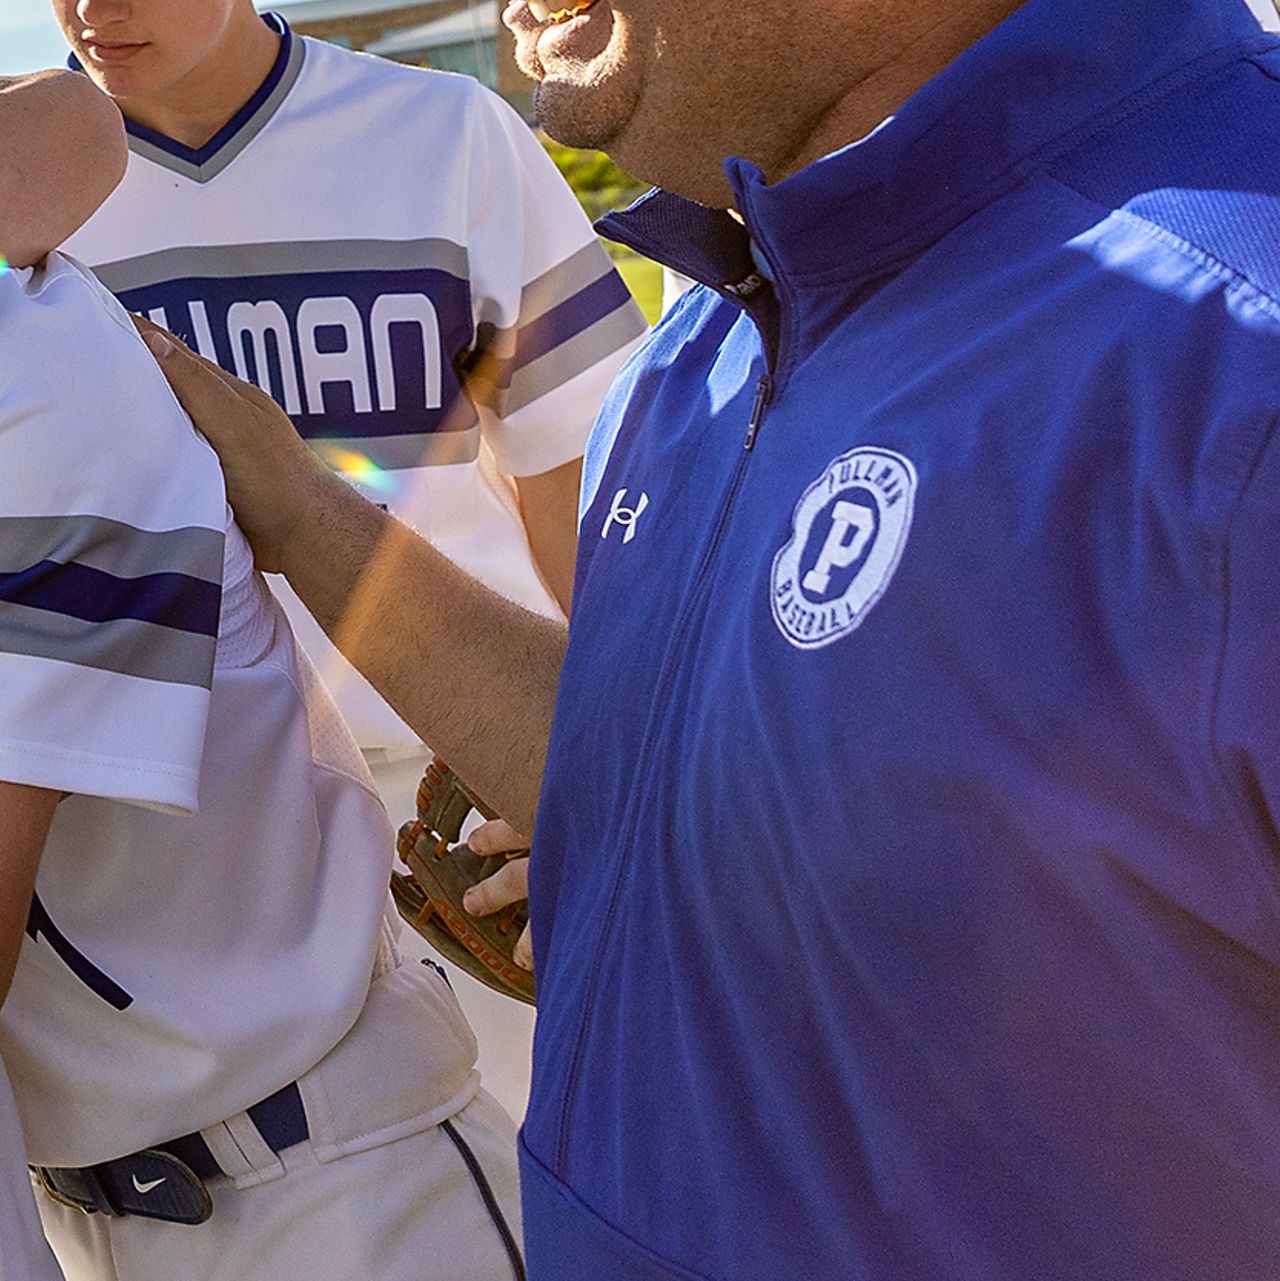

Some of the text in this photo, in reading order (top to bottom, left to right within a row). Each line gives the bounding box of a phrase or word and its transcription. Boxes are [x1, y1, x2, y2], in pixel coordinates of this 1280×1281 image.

[827, 460, 904, 509] PULLMAN
[802, 500, 875, 595] P
[777, 579, 856, 635] BASEBALL
